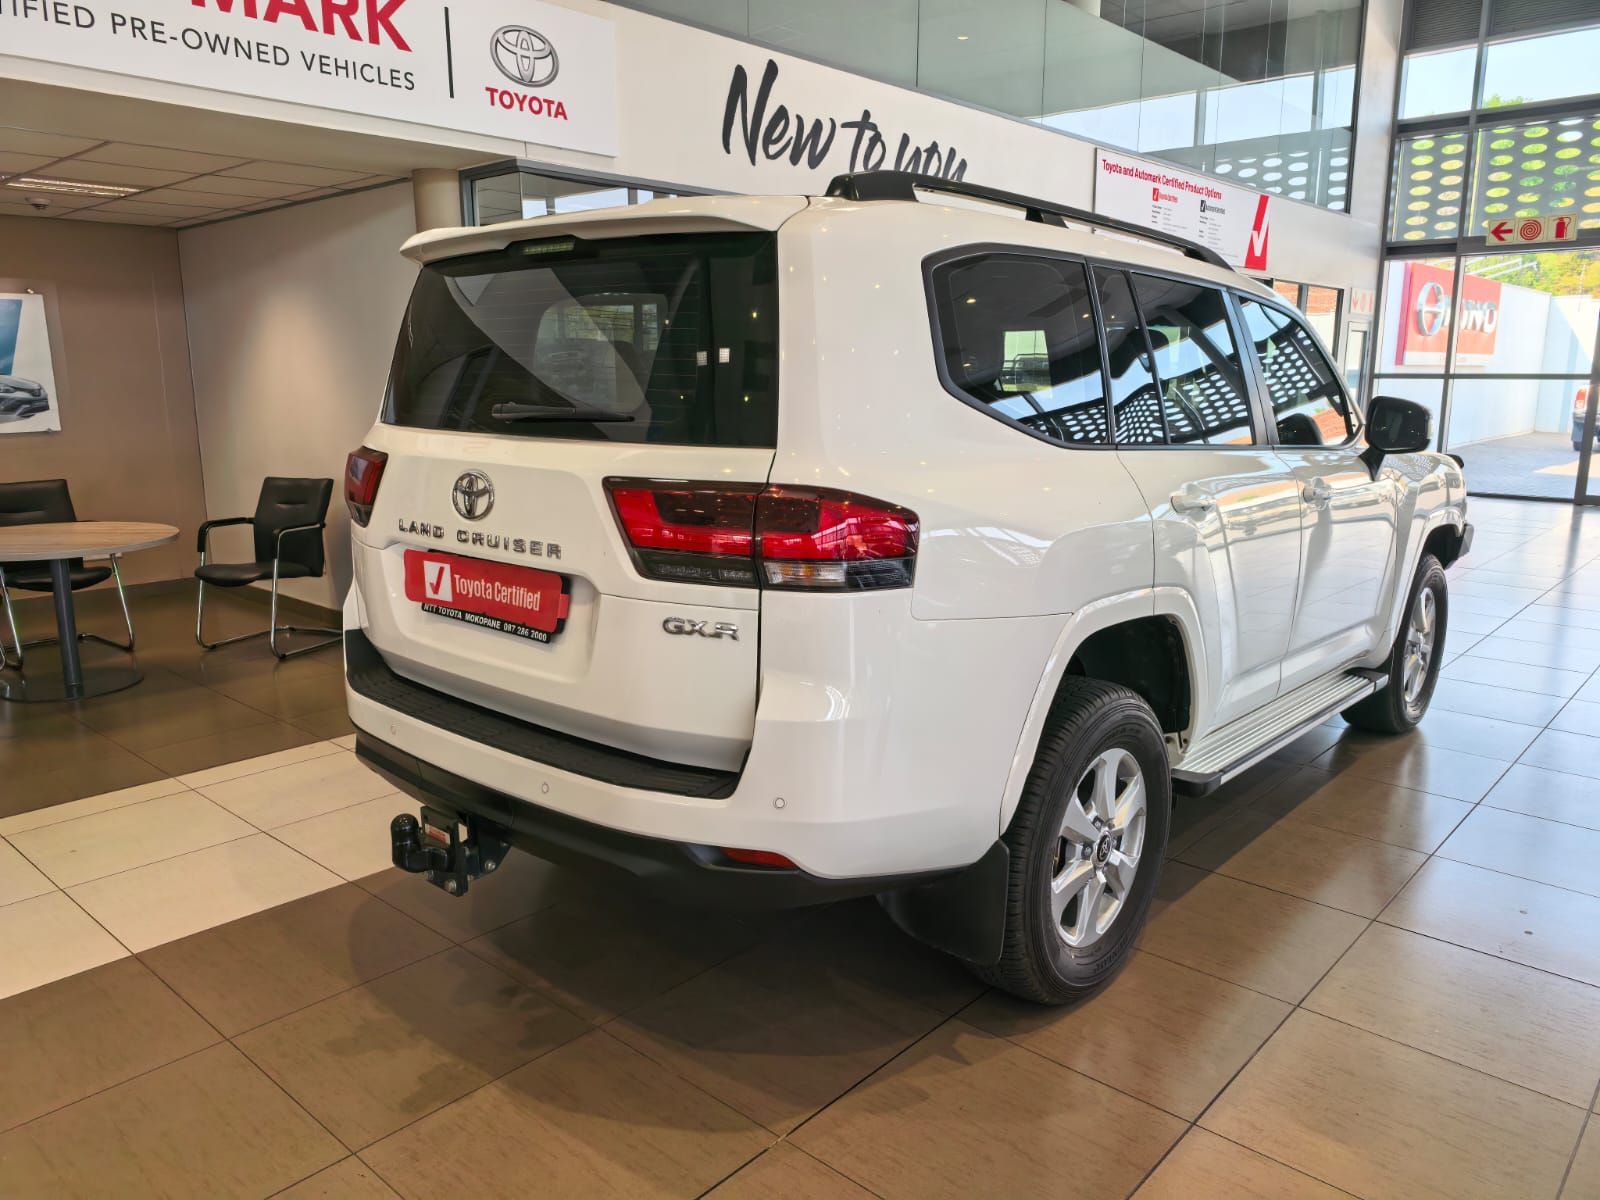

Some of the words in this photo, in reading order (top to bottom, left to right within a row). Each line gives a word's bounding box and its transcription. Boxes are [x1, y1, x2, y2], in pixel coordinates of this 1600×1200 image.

[0, 0, 96, 29] IFIED
[110, 12, 290, 66] PRE-OWNED
[300, 50, 415, 91] VEHICLES
[190, 0, 413, 53] ARK
[485, 86, 568, 121] TOYOTA
[722, 59, 837, 170] New
[841, 109, 887, 172] to
[1102, 159, 1122, 174] Toyota
[1122, 165, 1134, 177] and
[1134, 168, 1161, 184] Automark
[1162, 175, 1185, 190] Certified
[1185, 181, 1204, 195] Product
[1205, 186, 1222, 200] Options
[398, 518, 445, 539] LAND
[456, 529, 562, 560] CRUISER
[454, 574, 492, 600] Toyota
[494, 582, 541, 611] Certified
[438, 606, 462, 620] TOYOTA
[464, 612, 501, 629] MOKOPANE
[662, 616, 740, 642] GXR
